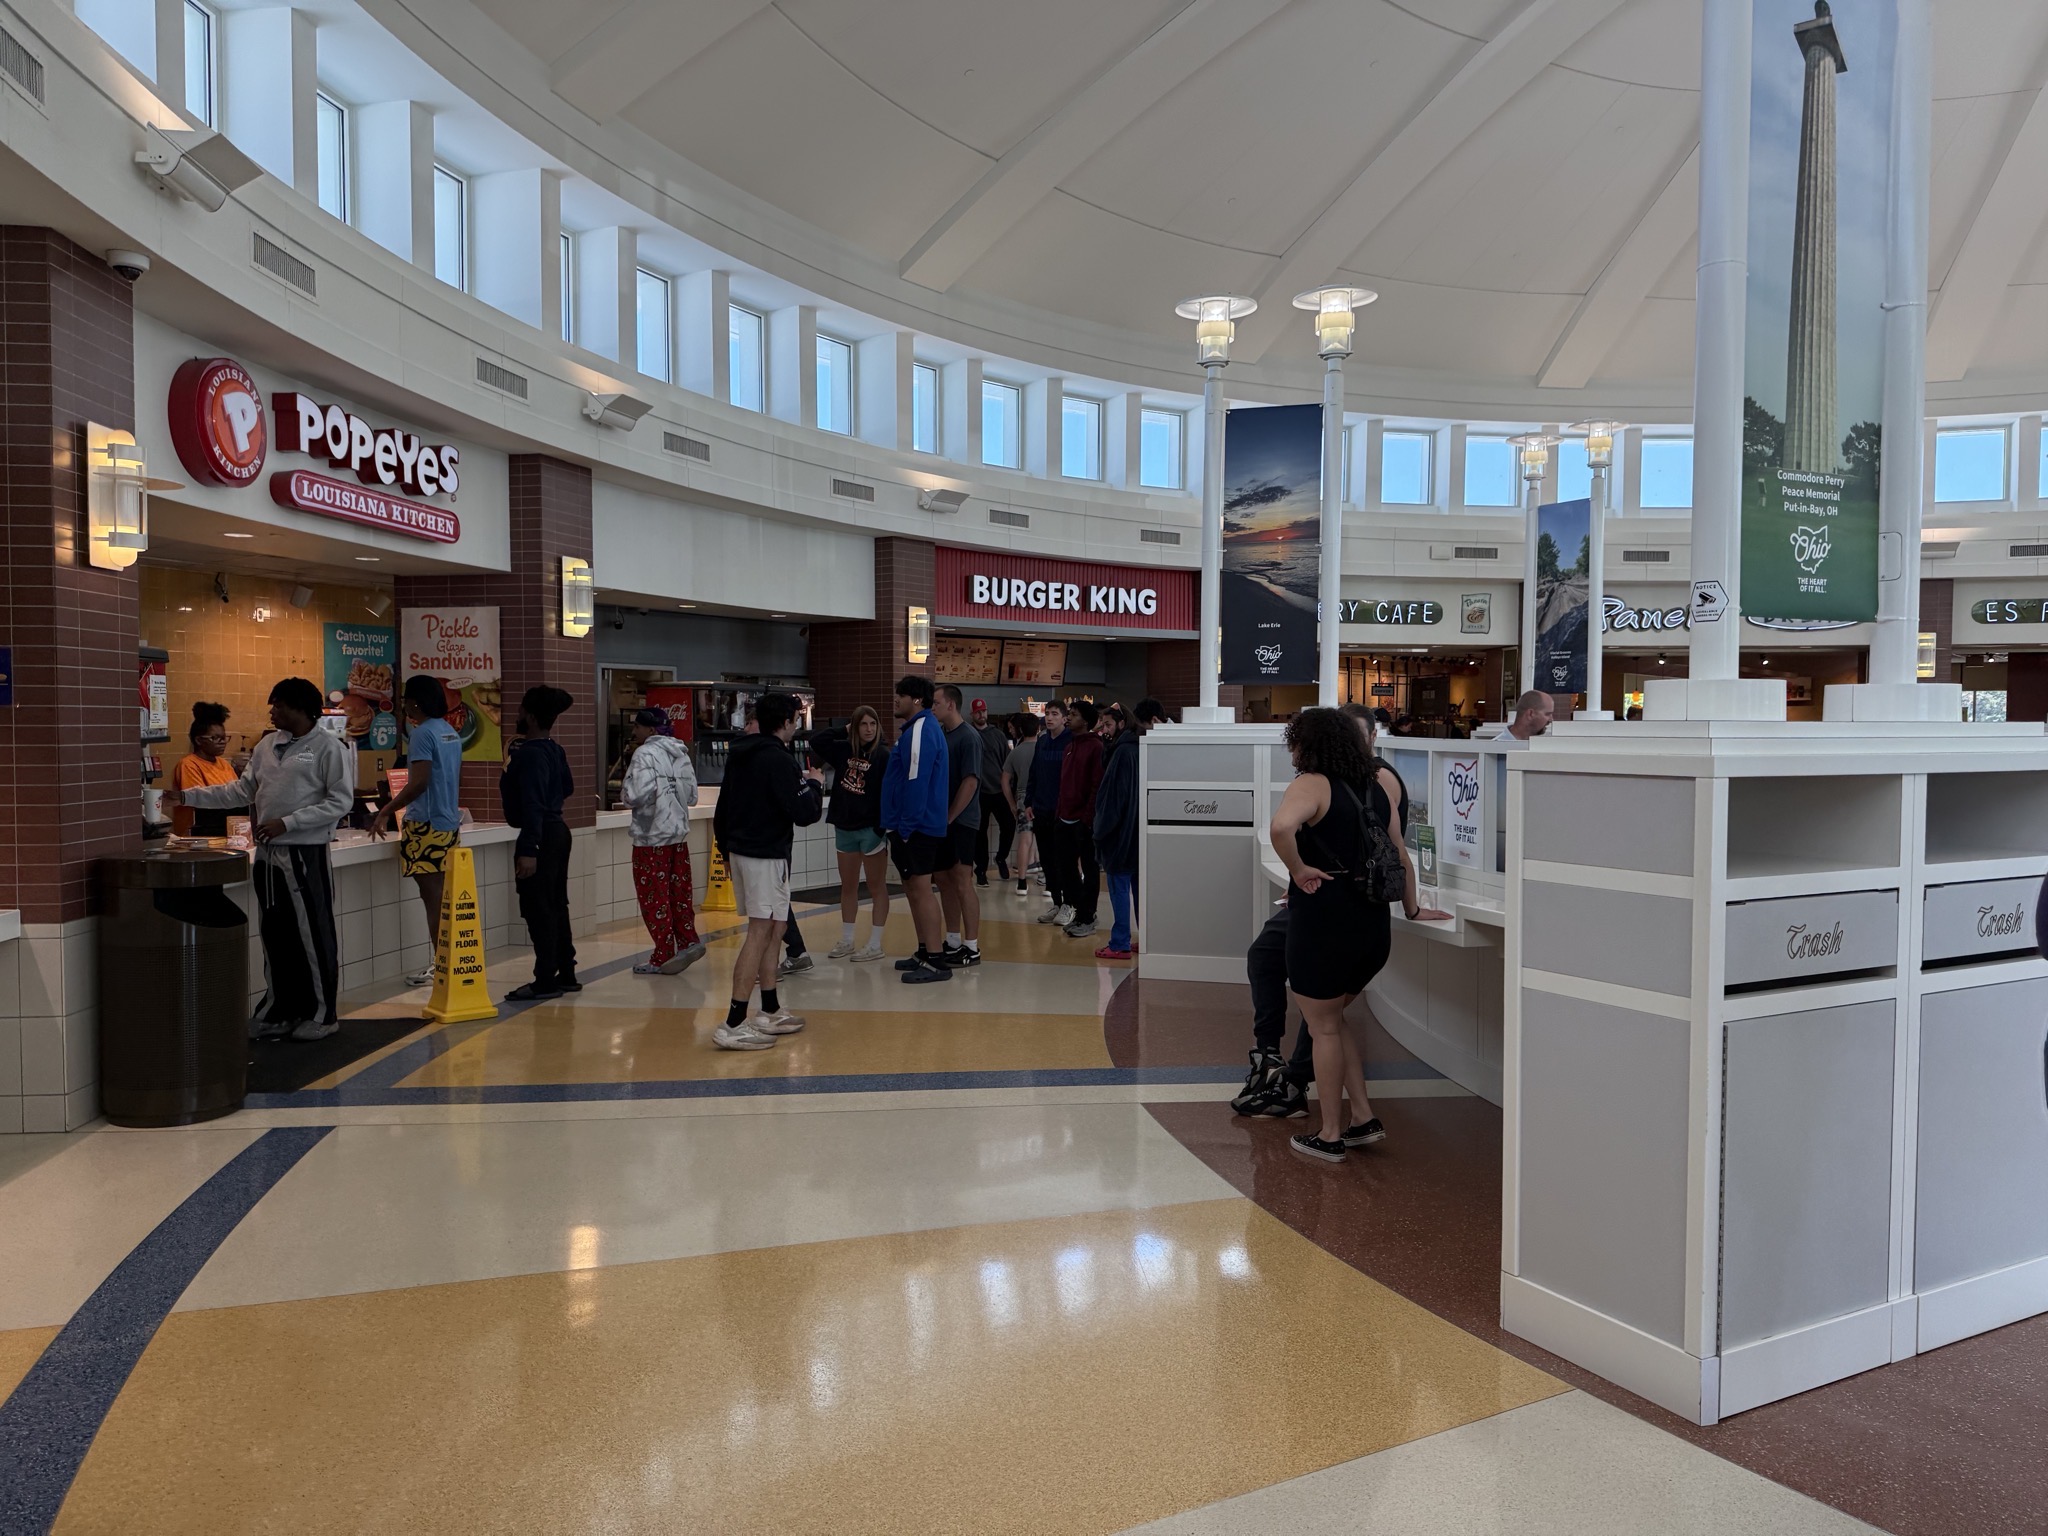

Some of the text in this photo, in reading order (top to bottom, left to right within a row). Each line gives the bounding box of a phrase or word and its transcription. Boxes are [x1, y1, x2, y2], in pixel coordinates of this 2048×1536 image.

[208, 368, 262, 412] LOUISIANA
[222, 391, 258, 454] P
[213, 445, 261, 479] KITCHEN
[1777, 470, 1845, 488] Commodore Perry
[1782, 486, 1840, 501] Peace Memorial
[302, 480, 454, 535] LOUISIANA KITCHEN
[1784, 502, 1838, 517] Put-in-Bay, OH
[1790, 533, 1831, 562] Ohio
[1798, 577, 1827, 586] THE HEART
[973, 575, 1157, 616] BURGER KING
[1376, 602, 1434, 624] CAFE
[1602, 598, 1690, 631] Pane
[421, 614, 479, 639] Pickle
[336, 630, 389, 645] Catch your
[342, 644, 384, 656] favorite!
[437, 640, 465, 656] Glaze
[1255, 649, 1283, 661] Ohio
[409, 653, 494, 670] Sandwich
[1448, 771, 1479, 805] Ohio
[1184, 800, 1218, 814] Trash
[1454, 824, 1477, 835] THE HEART
[1462, 834, 1467, 842] IT
[456, 902, 475, 911] CAUTION
[1977, 903, 2024, 937] Trash
[459, 929, 474, 938] WET
[1786, 921, 1844, 959] Trash
[455, 939, 478, 949] FLOOR
[459, 955, 475, 965] PISO
[453, 966, 482, 976] MOJADO
